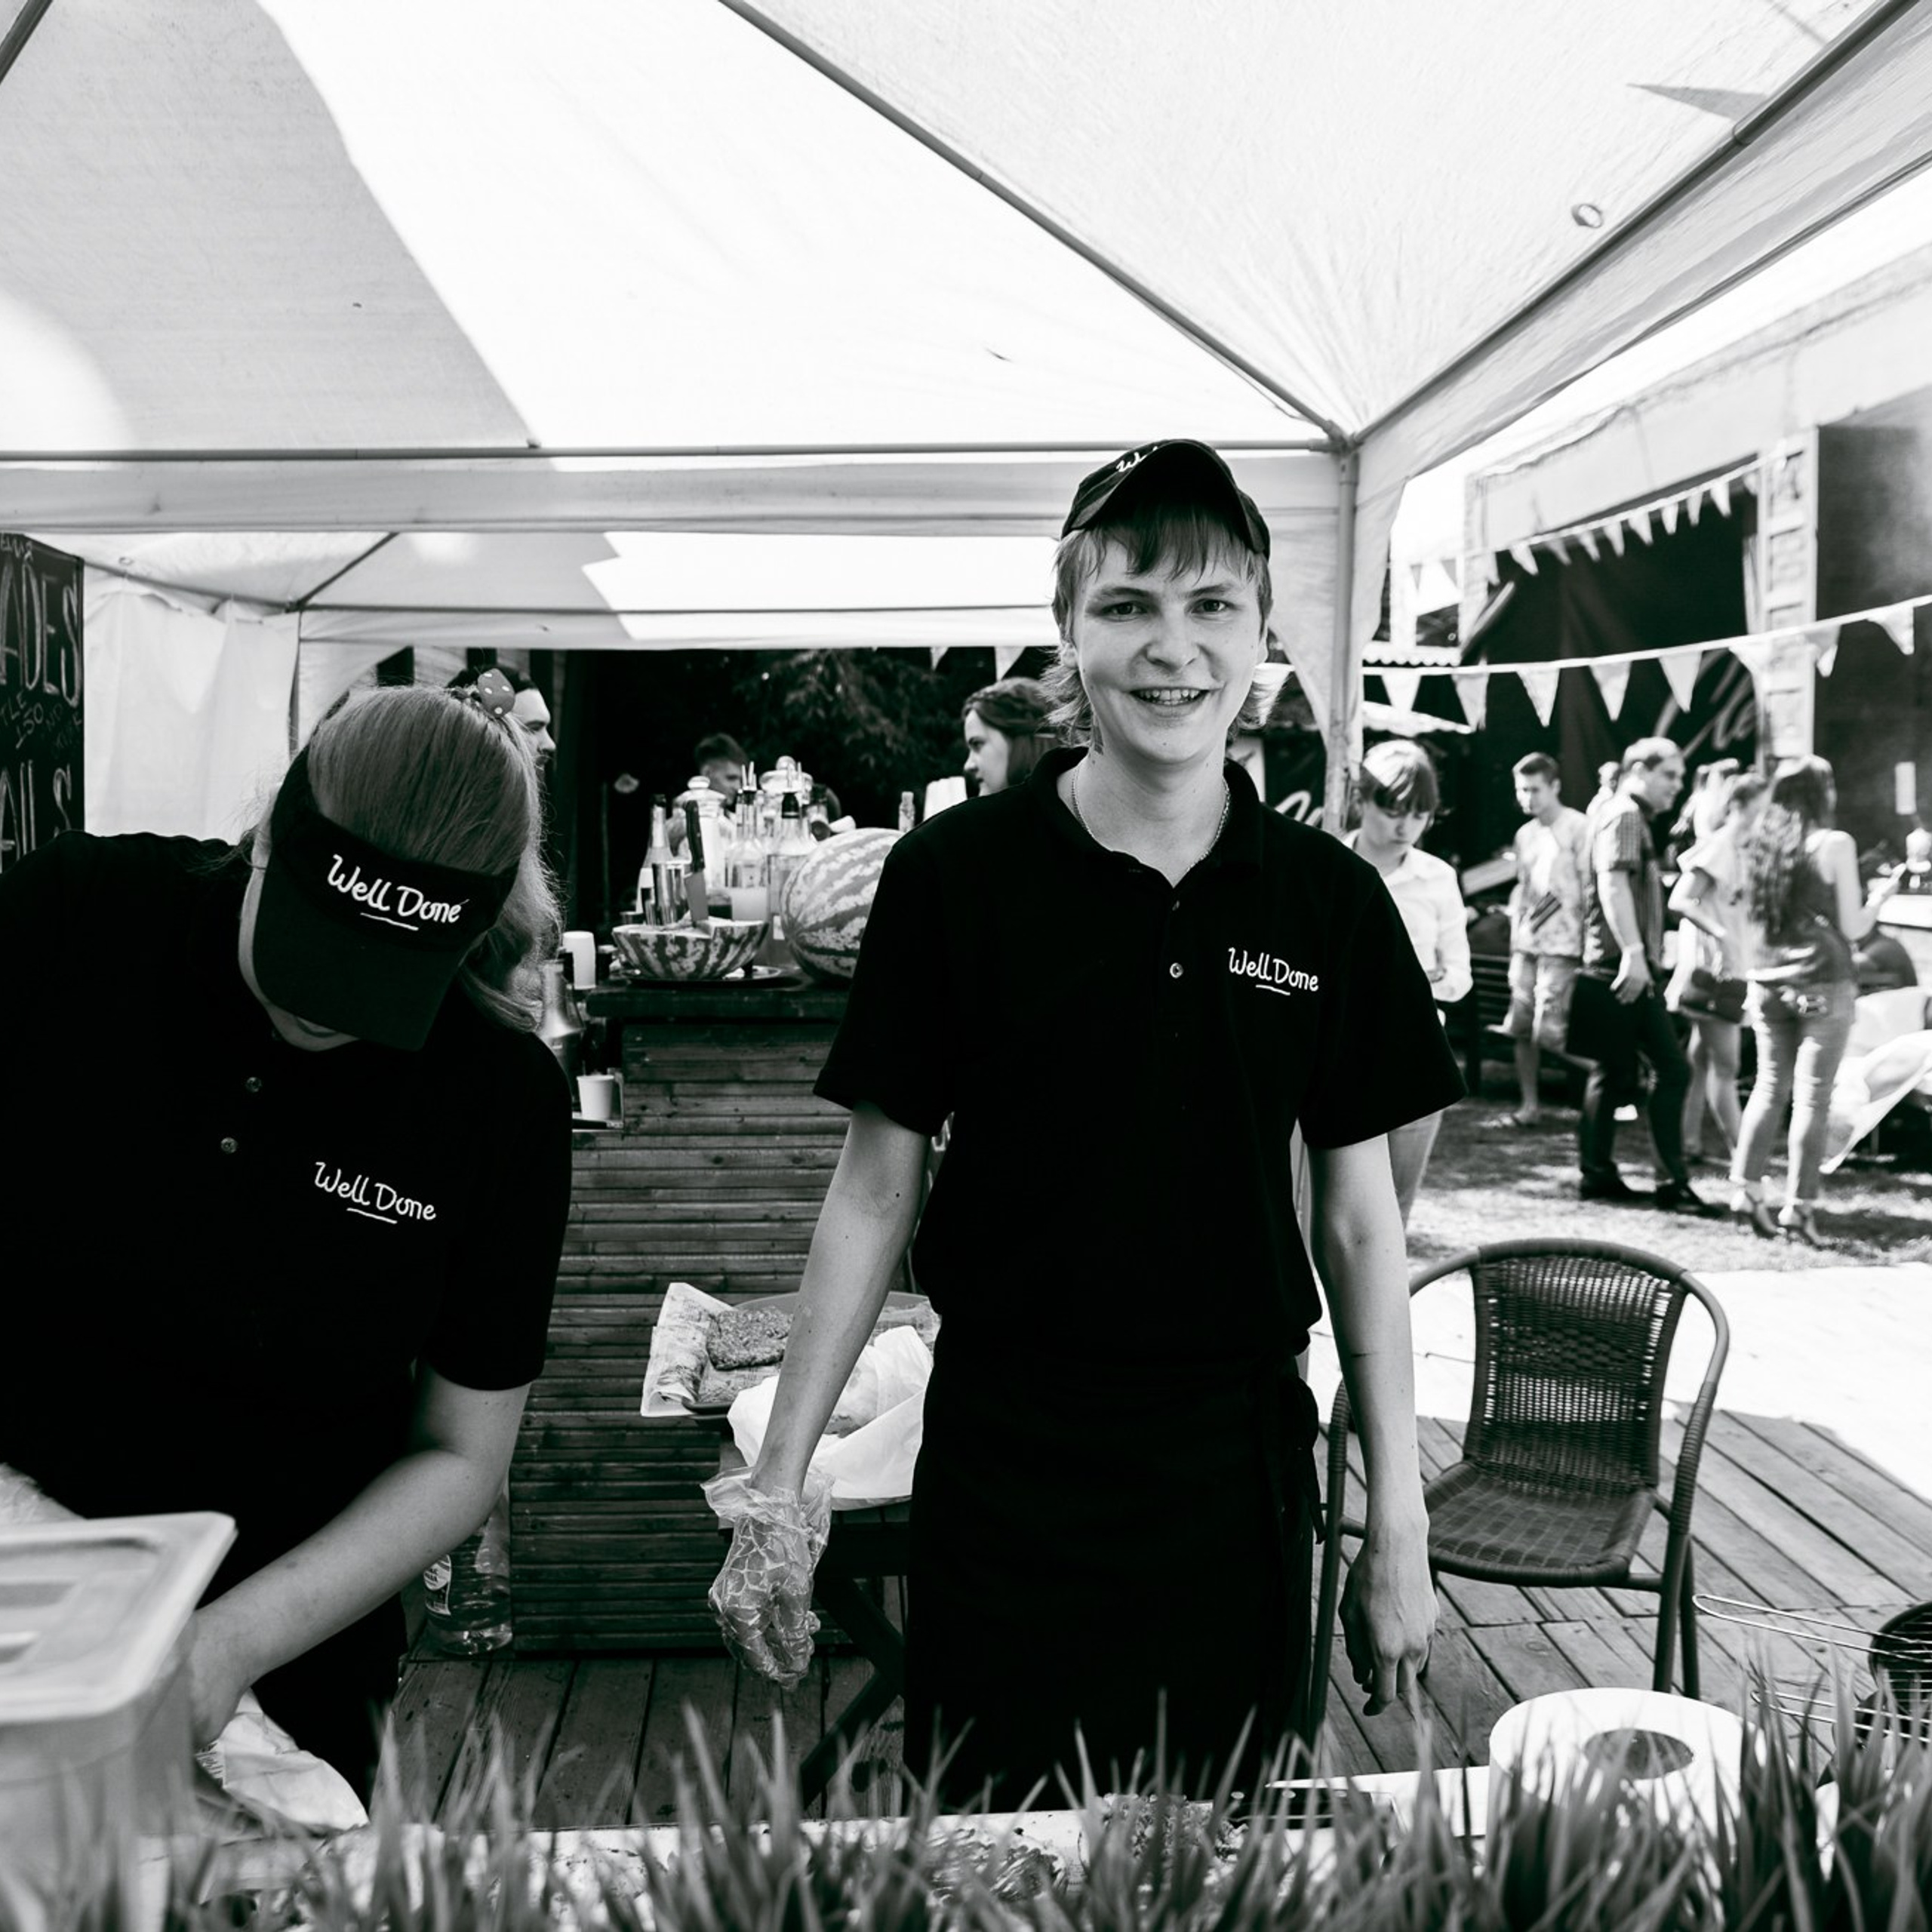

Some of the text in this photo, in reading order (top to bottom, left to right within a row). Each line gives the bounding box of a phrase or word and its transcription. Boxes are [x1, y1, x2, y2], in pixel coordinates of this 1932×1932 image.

[327, 854, 463, 924] Well Done
[1228, 947, 1319, 992] Well Done
[314, 1161, 436, 1221] Well Done
